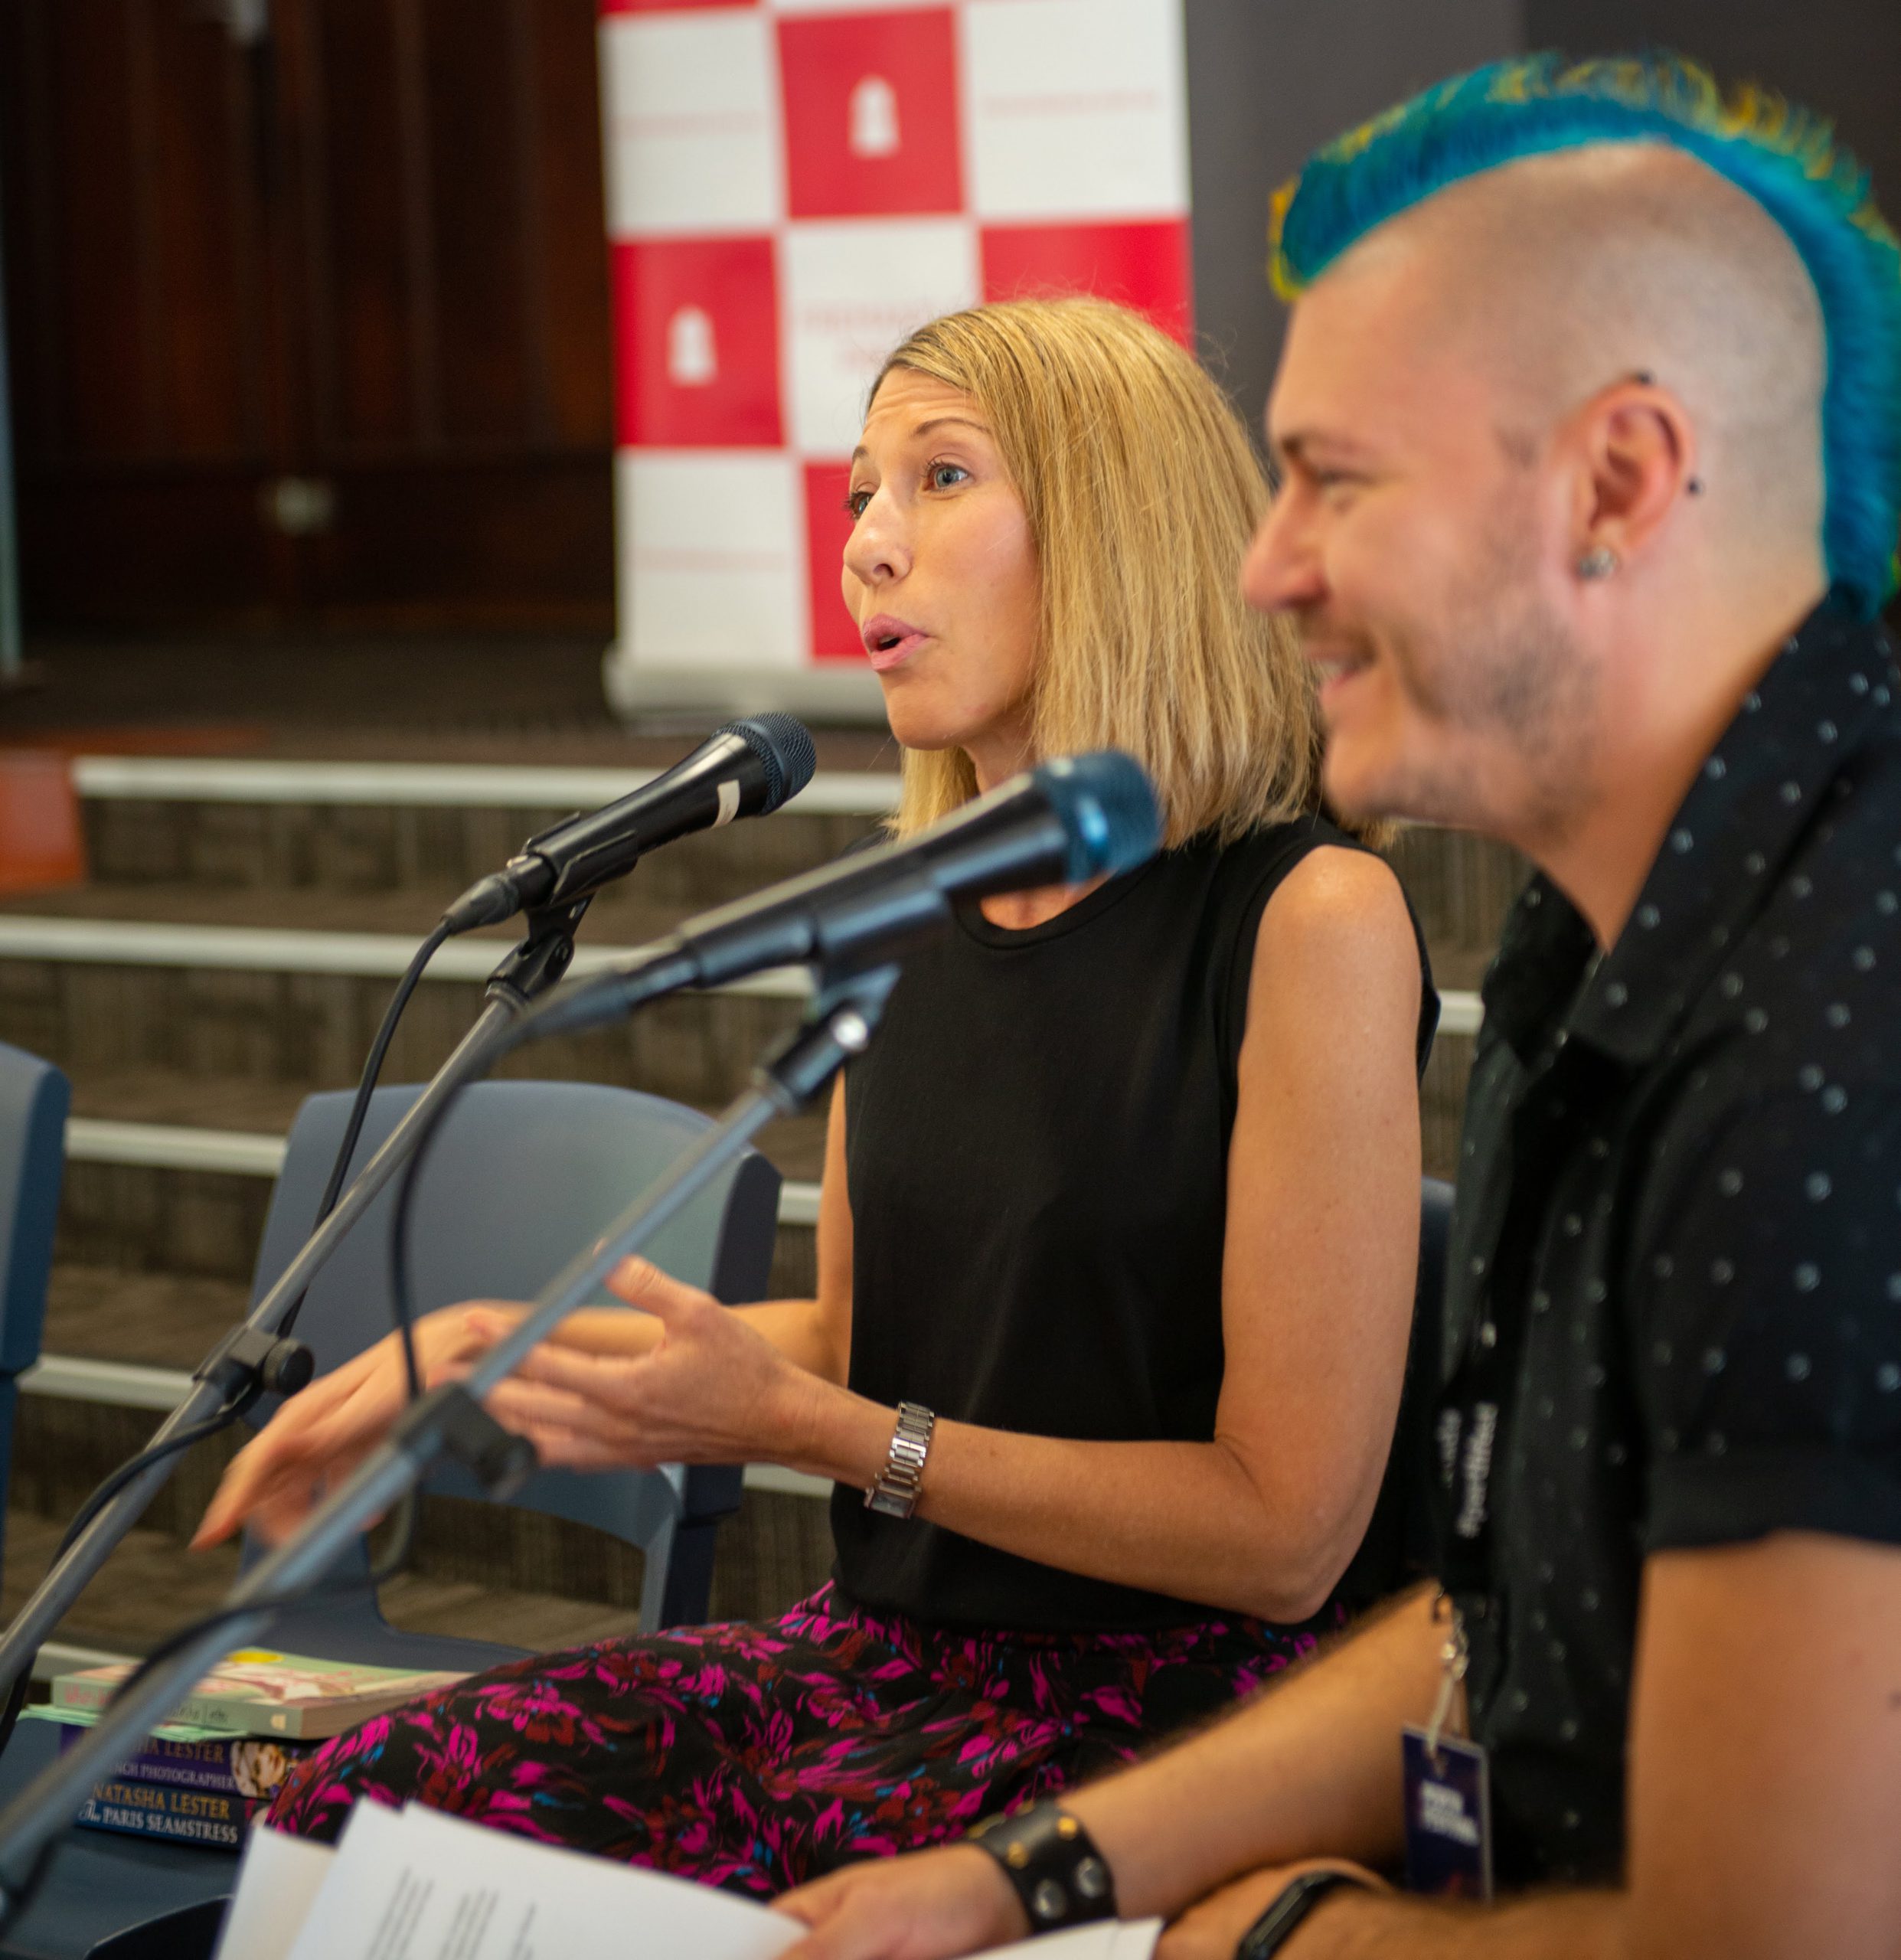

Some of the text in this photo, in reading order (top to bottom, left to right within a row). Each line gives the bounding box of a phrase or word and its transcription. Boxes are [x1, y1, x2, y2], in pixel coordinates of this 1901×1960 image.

[165, 1739, 224, 1764] LESTER
[142, 1762, 236, 1791] PHOTOGRAPHER
[93, 1782, 230, 1820] NATASHA LESTER
[79, 1800, 238, 1844] The PARIS SEAMSTRESS
